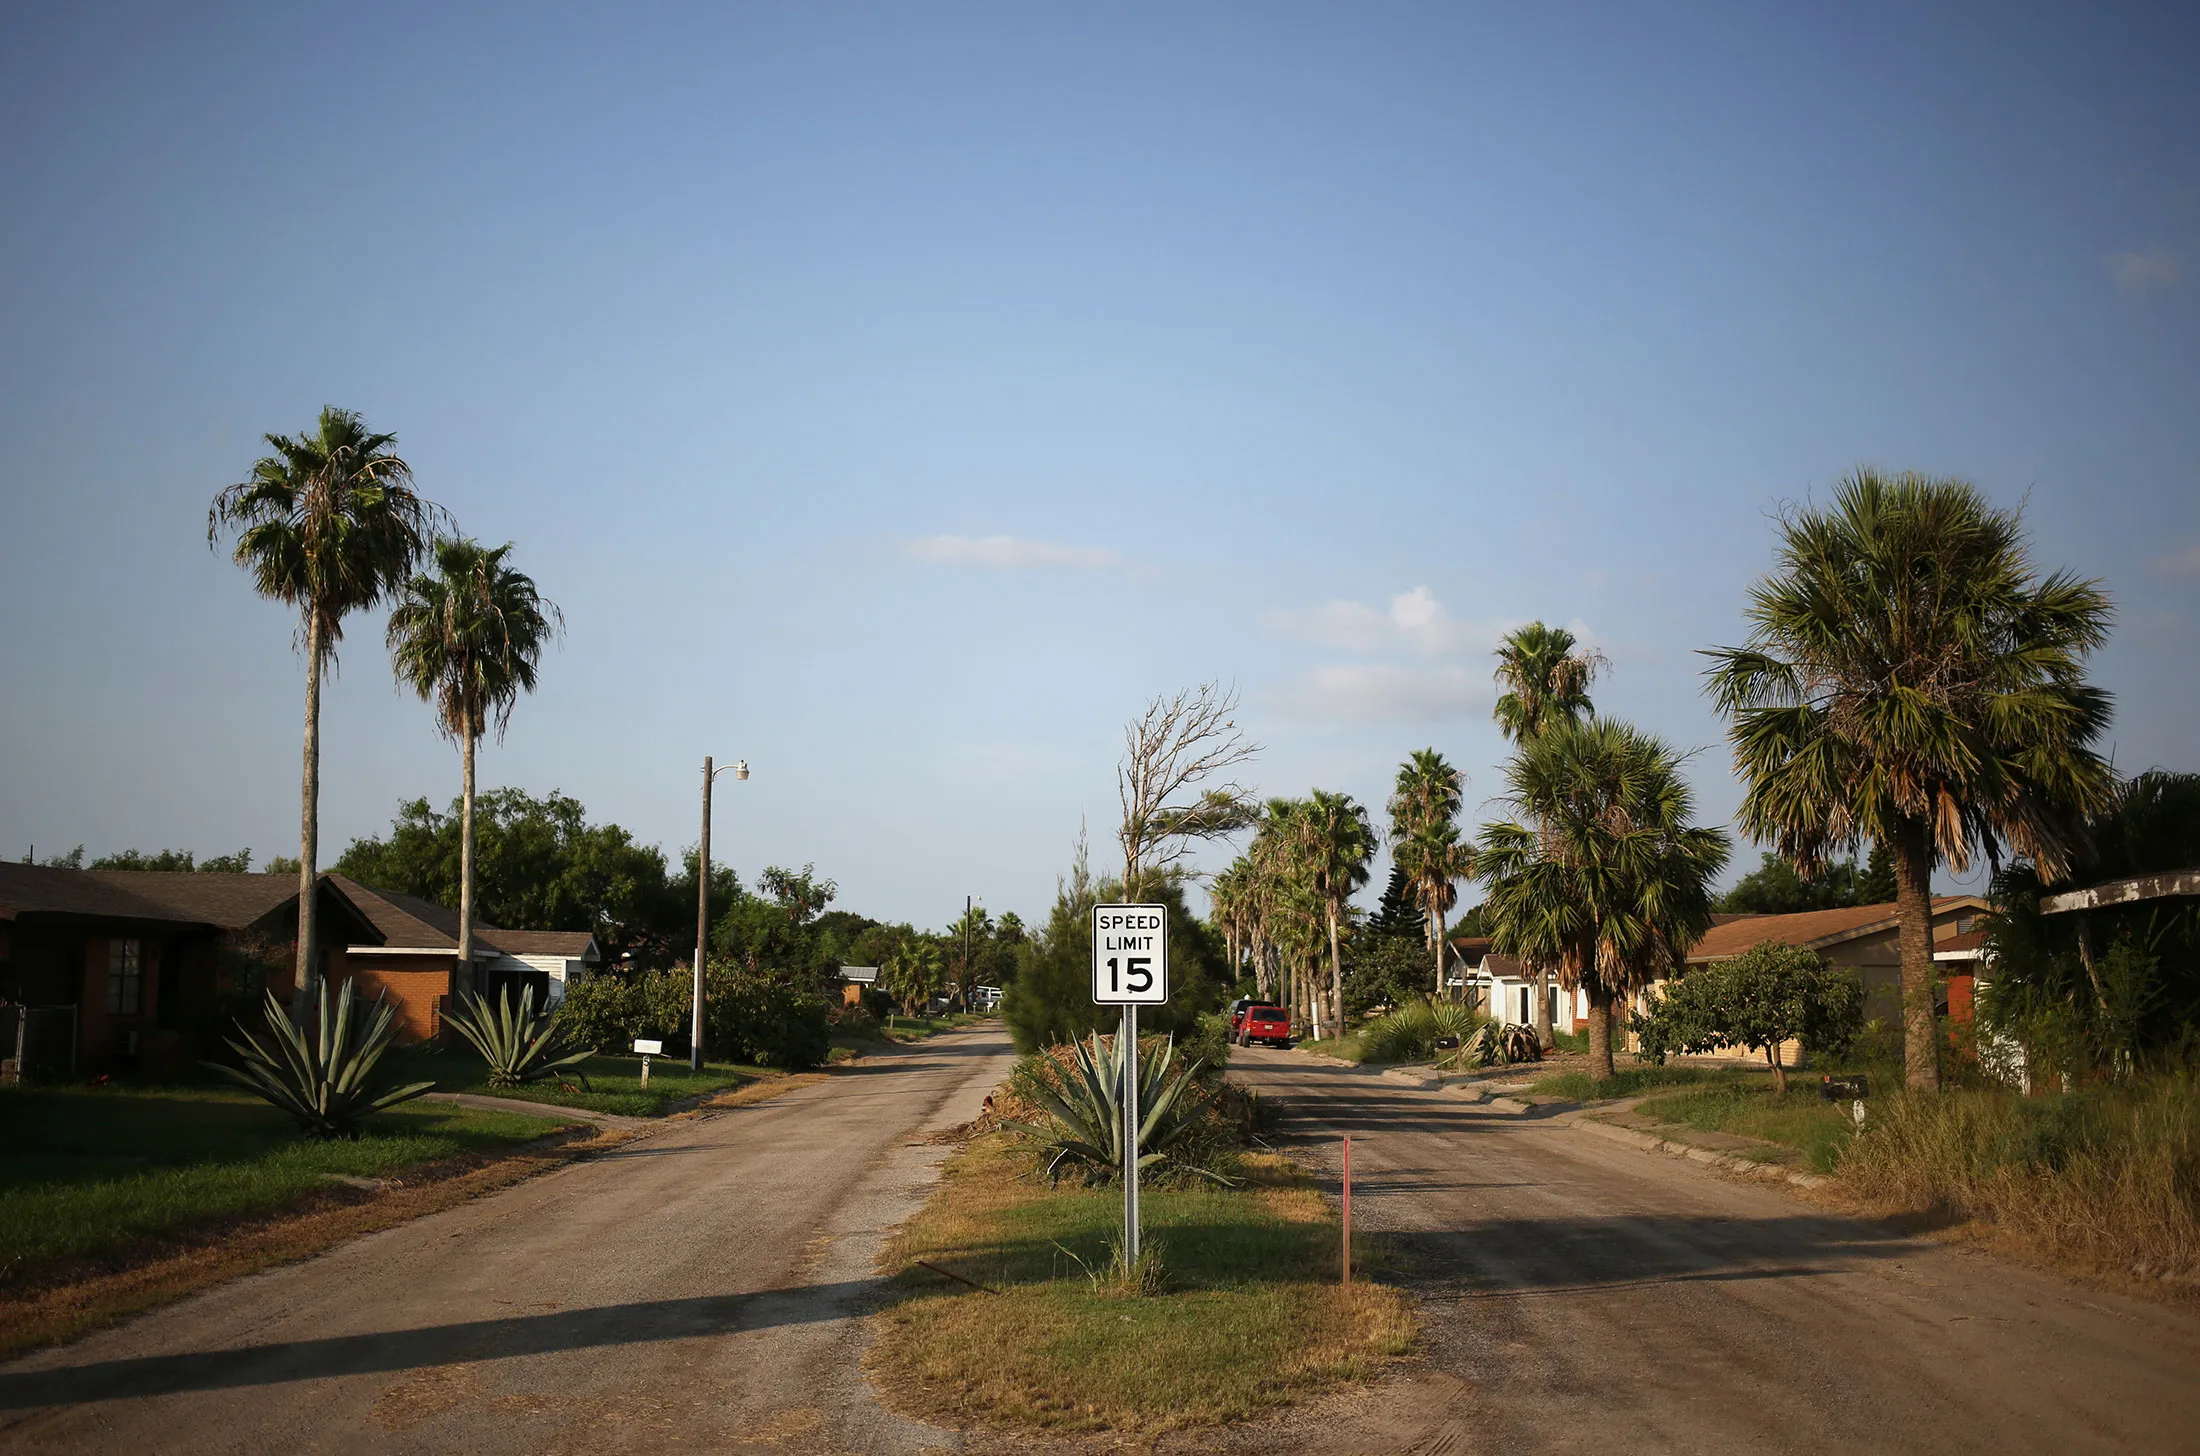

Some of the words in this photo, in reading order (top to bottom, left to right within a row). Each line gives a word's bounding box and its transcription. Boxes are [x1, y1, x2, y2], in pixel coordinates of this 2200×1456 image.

[1099, 915, 1161, 930] SPEED
[1106, 936, 1154, 950] LIMIT
[1106, 957, 1154, 993] 15
